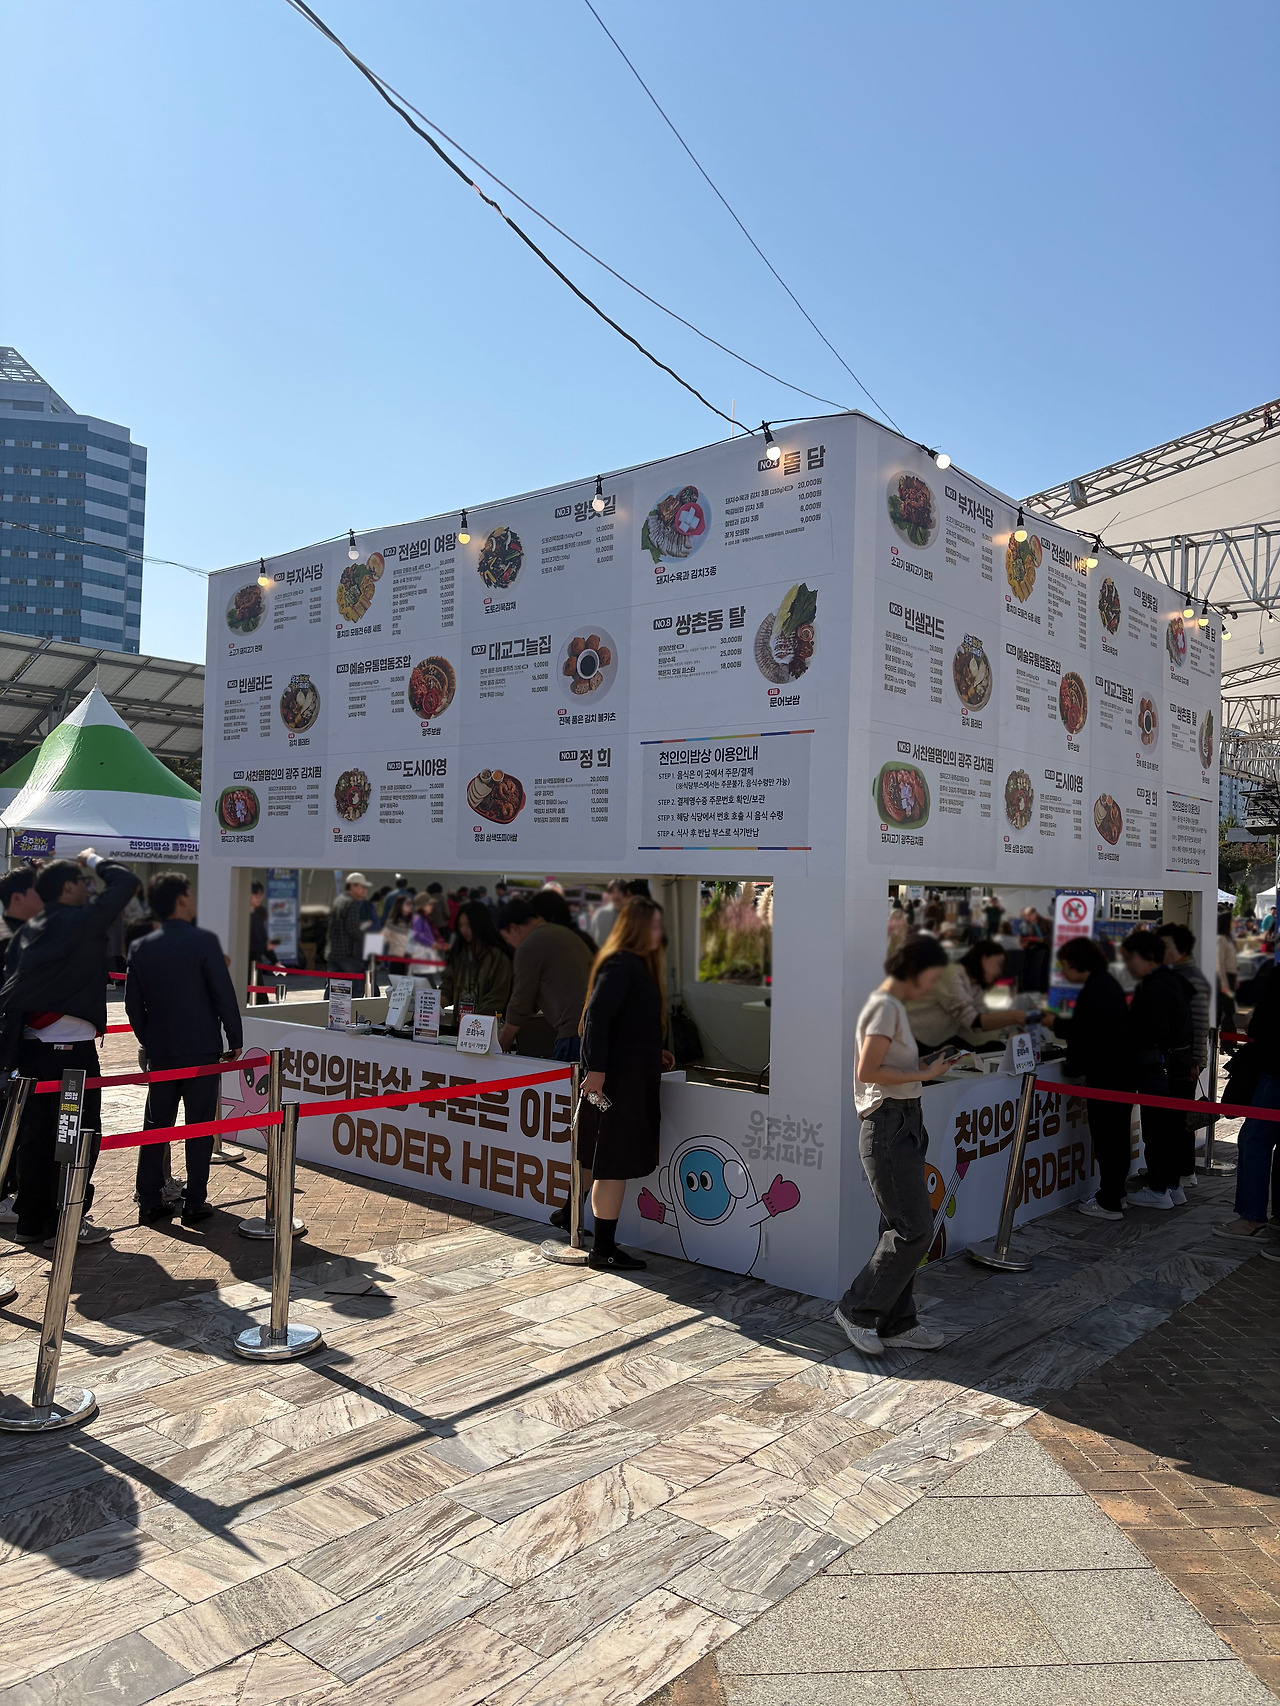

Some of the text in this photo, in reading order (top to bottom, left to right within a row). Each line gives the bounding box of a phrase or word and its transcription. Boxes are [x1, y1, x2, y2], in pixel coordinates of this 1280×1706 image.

[808, 445, 826, 470] 담
[798, 478, 822, 489] 20,000원
[798, 490, 822, 500] 10,000원
[800, 514, 822, 524] 9,000원
[958, 492, 994, 528] 부자식당
[399, 538, 431, 562] 전설의
[434, 532, 456, 554] 여왕
[286, 563, 323, 585] 부자식당
[653, 617, 673, 630] NO.8
[676, 609, 724, 636] 쌍촌동
[489, 634, 551, 660] 대교그늘집
[350, 655, 411, 675] 예술유통협동조합
[770, 695, 800, 708] 문어보쌈
[584, 713, 597, 724] 김치
[559, 748, 611, 769] NO.11 정 희
[659, 745, 759, 766] 천인의밥상 이용안내
[285, 768, 299, 780] 광주
[301, 766, 322, 779] 김치찜
[403, 758, 447, 778] 도시야영
[677, 770, 696, 780] 음식은
[775, 777, 791, 786] 가능)
[1056, 771, 1083, 793] 도시야영
[709, 795, 735, 805] 주문번호
[676, 812, 689, 822] 해당
[690, 812, 716, 822] 식당에서
[716, 811, 730, 821] 번호
[746, 811, 753, 820] 시
[754, 810, 768, 820] 음식
[769, 810, 784, 820] 수령
[676, 828, 689, 838] 식사
[690, 828, 697, 838] 후
[698, 828, 711, 838] 반납
[712, 828, 732, 837] 부스로
[733, 827, 759, 838] 식기반납
[129, 840, 170, 851] 천인의밥상
[281, 1048, 412, 1111] 천인의밥상
[419, 1070, 510, 1132] 주문은
[332, 1113, 571, 1208] ORDER HERE
[741, 1134, 823, 1169] 김치파티
